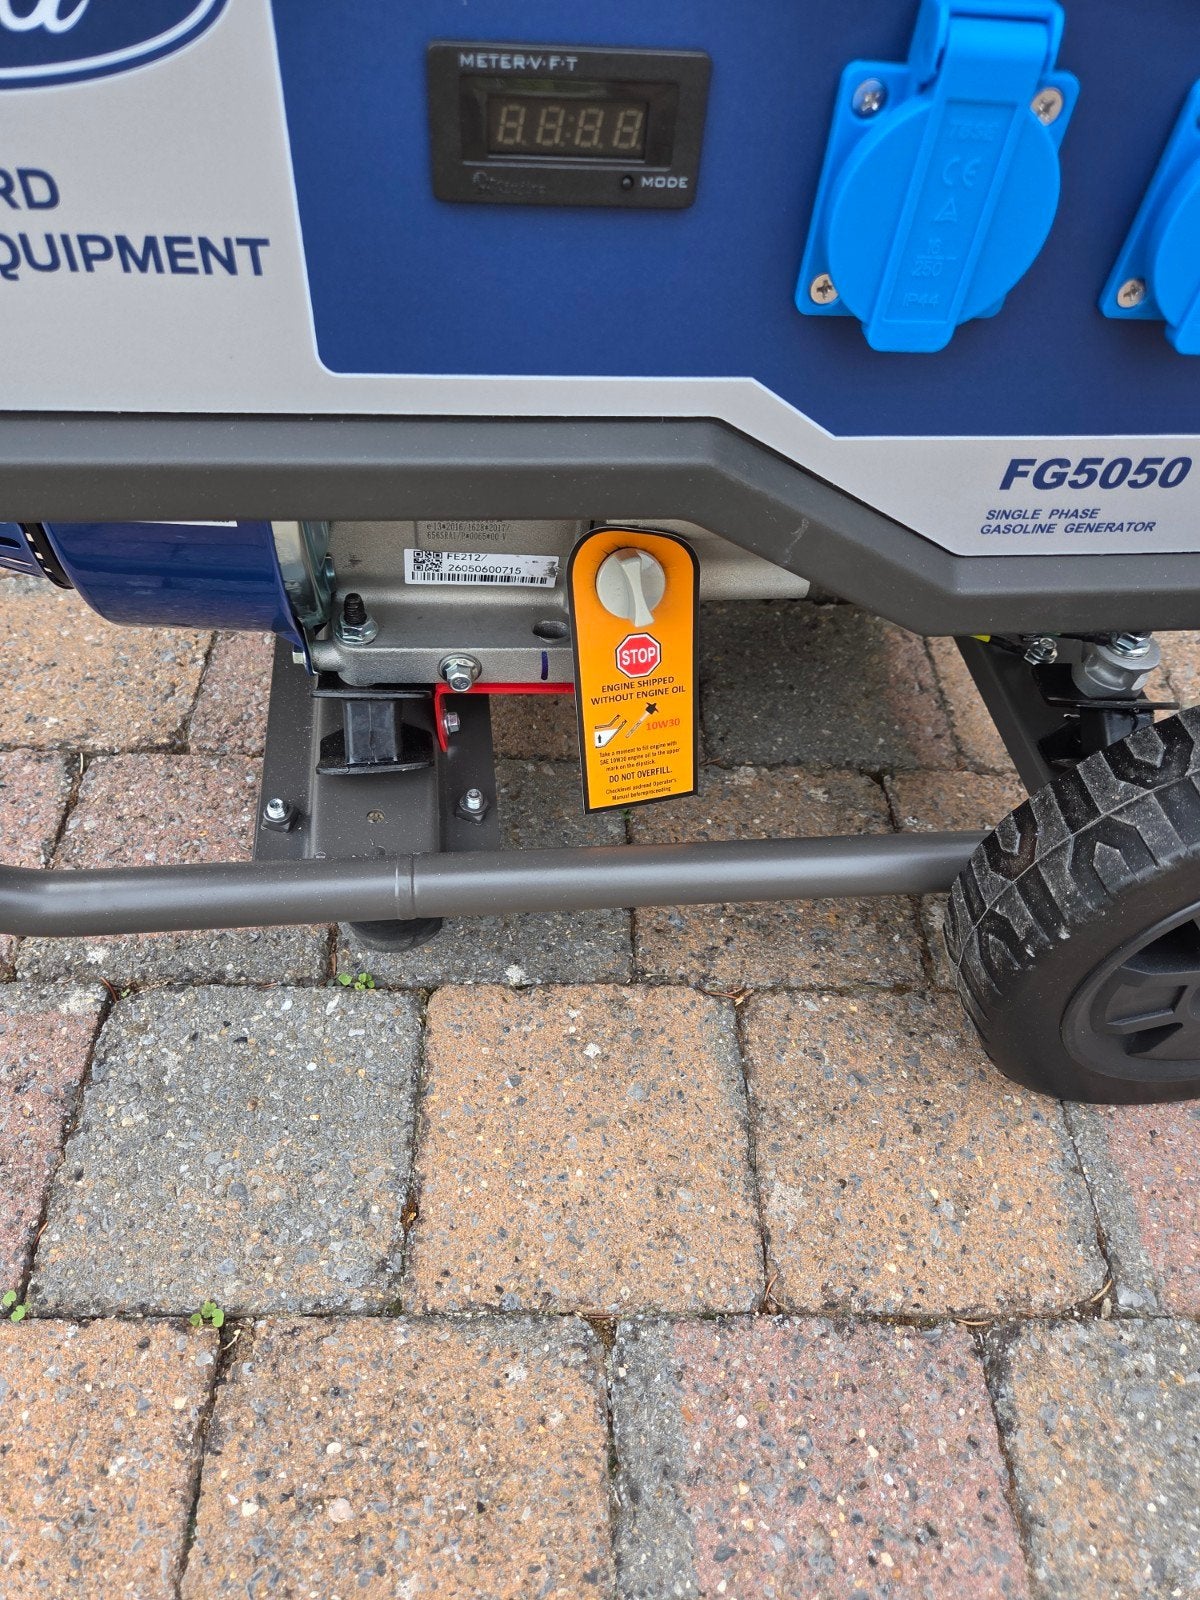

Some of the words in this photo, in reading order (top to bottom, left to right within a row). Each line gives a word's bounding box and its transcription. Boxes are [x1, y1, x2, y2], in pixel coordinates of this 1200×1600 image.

[641, 176, 688, 189] MODE
[999, 456, 1193, 490] FG5050
[985, 509, 1042, 520] SINGLE
[1048, 508, 1100, 519] PHASE
[980, 523, 1057, 535] GASOLINE
[1063, 521, 1156, 534] GENERATOR
[448, 564, 521, 575] 26050600715
[621, 647, 655, 666] STOP
[601, 682, 635, 693] ENGINE
[637, 676, 674, 688] SHIPPED
[591, 692, 634, 705] WITHOUT
[636, 688, 669, 699] ENGINE
[671, 685, 686, 694] OIL
[646, 718, 680, 731] 10W30
[600, 758, 609, 766] SAE
[628, 754, 644, 762] engine
[666, 747, 680, 756] upper
[616, 747, 635, 755] moment
[606, 764, 618, 772] mark
[609, 774, 620, 783] DO
[621, 771, 635, 781] NOT
[612, 793, 629, 801] Manual
